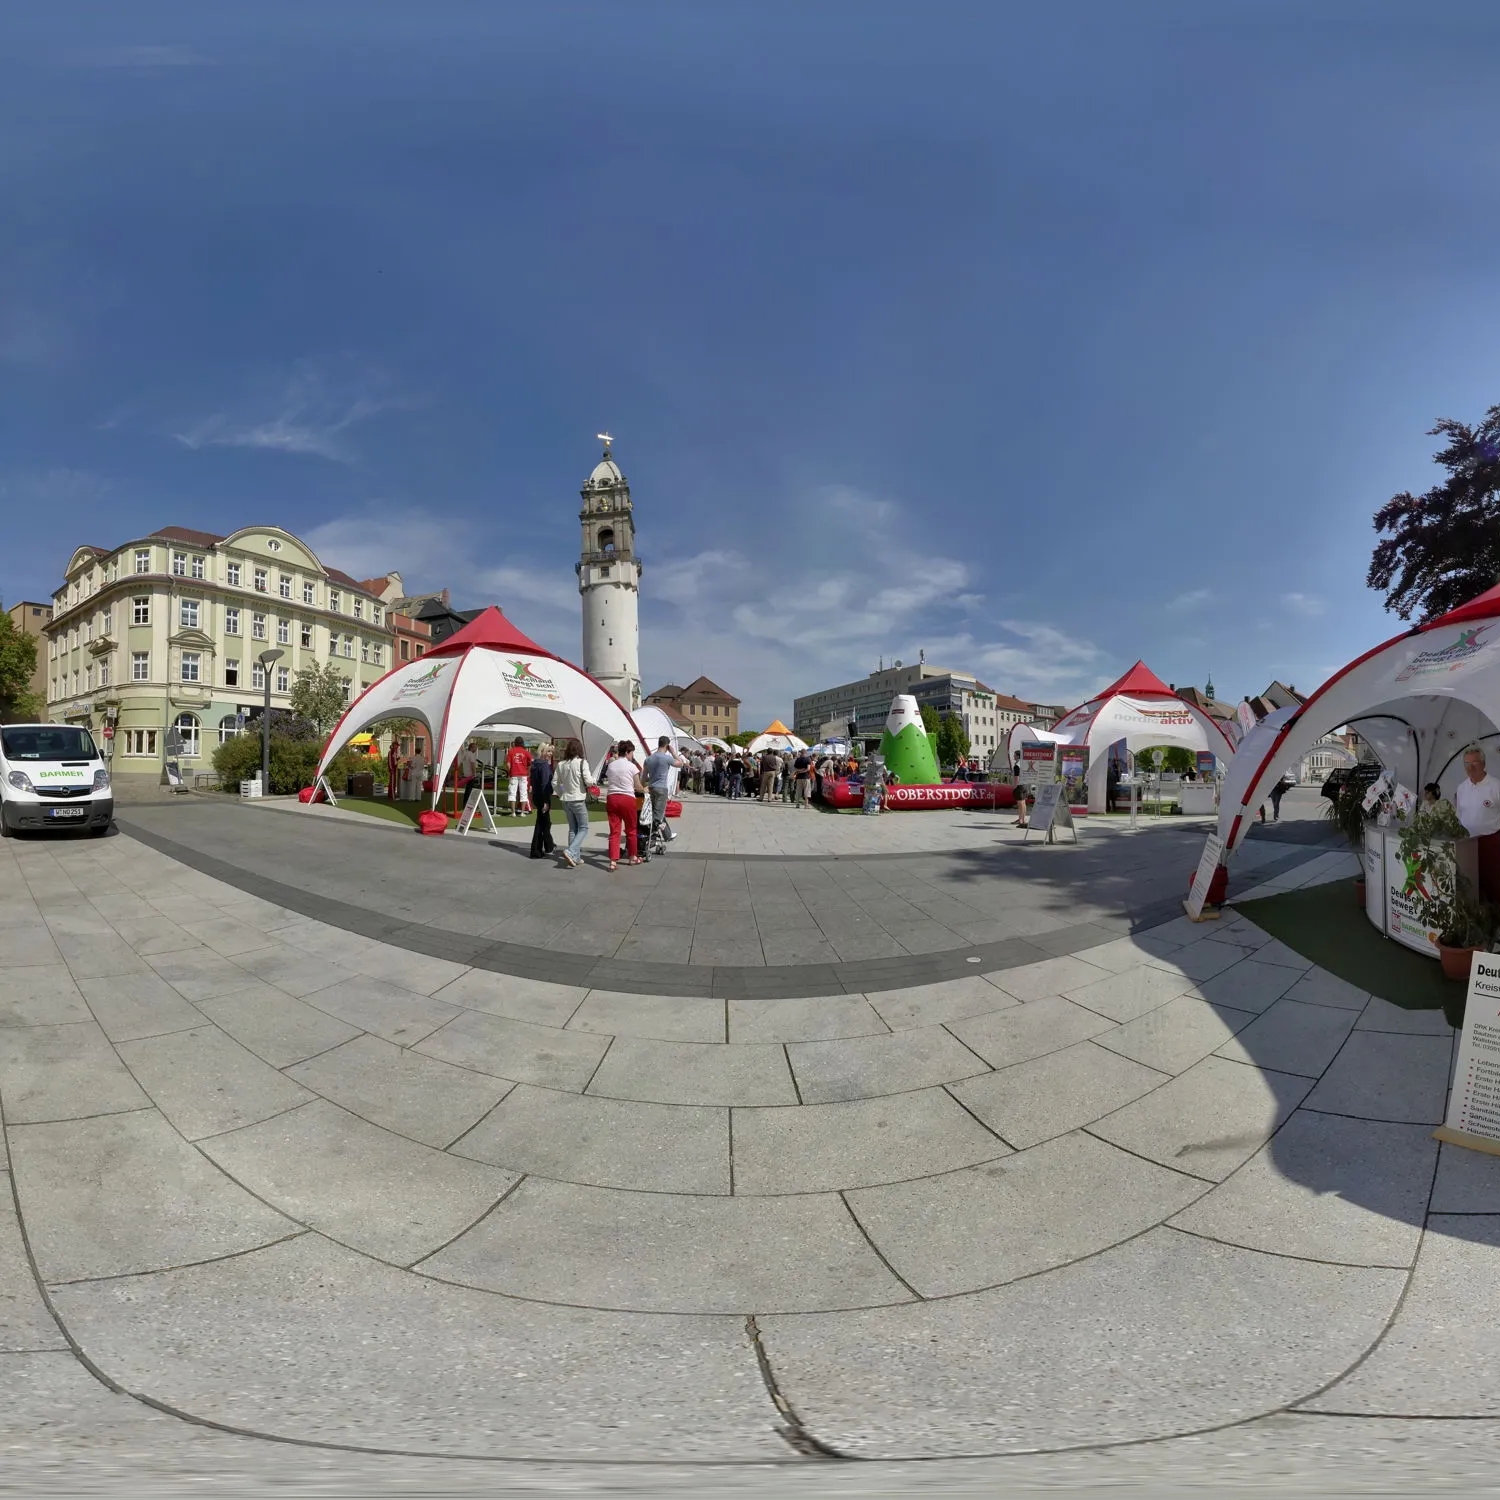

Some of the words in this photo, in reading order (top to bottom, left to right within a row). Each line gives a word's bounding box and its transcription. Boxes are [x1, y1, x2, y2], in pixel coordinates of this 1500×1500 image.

[503, 677, 534, 687] bewegt
[1160, 717, 1193, 725] aktiv
[1474, 1023, 1488, 1031] DRK
[1473, 1029, 1497, 1039] Bautzen
[1475, 1074, 1493, 1084] Erste
[1474, 1082, 1492, 1091] Erste
[1472, 1089, 1491, 1099] Erste
[1471, 1097, 1490, 1106] Erste
